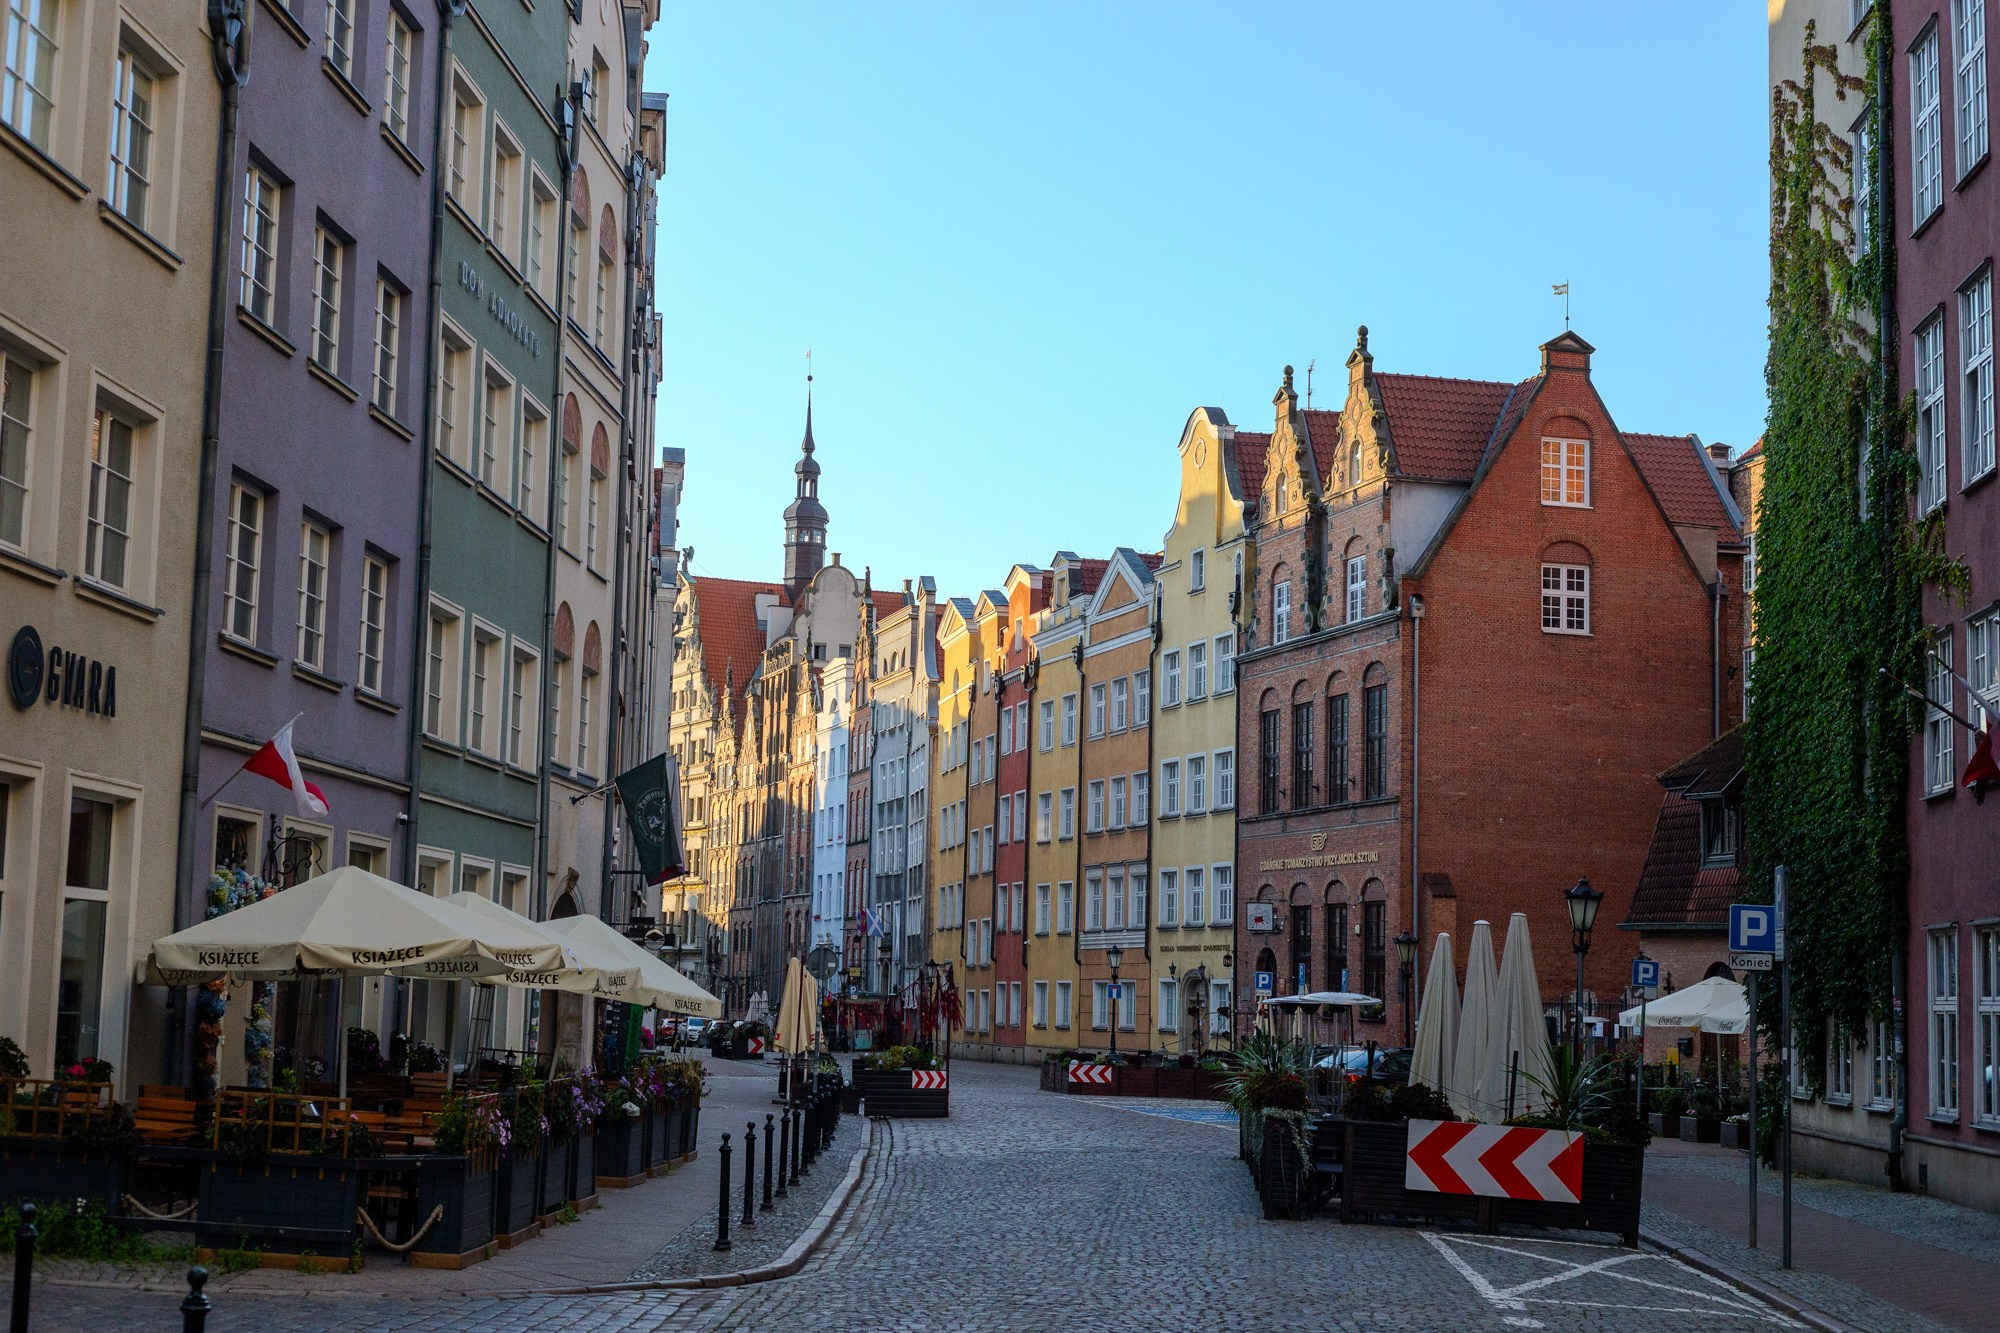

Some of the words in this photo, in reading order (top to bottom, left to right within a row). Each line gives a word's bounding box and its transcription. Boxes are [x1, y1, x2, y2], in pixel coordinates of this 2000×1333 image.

[462, 260, 484, 301] DOM
[48, 646, 116, 717] GVARA
[1357, 850, 1379, 863] SZTUKI
[1740, 910, 1768, 946] P
[198, 949, 260, 967] KSIĄŻĘCE
[351, 946, 425, 965] KSIĄŻĘCE
[495, 951, 536, 967] KSIĄŻĘCE
[1731, 955, 1771, 968] Koniec
[1258, 973, 1269, 988] P
[1638, 963, 1654, 984] P
[850, 986, 857, 994] P
